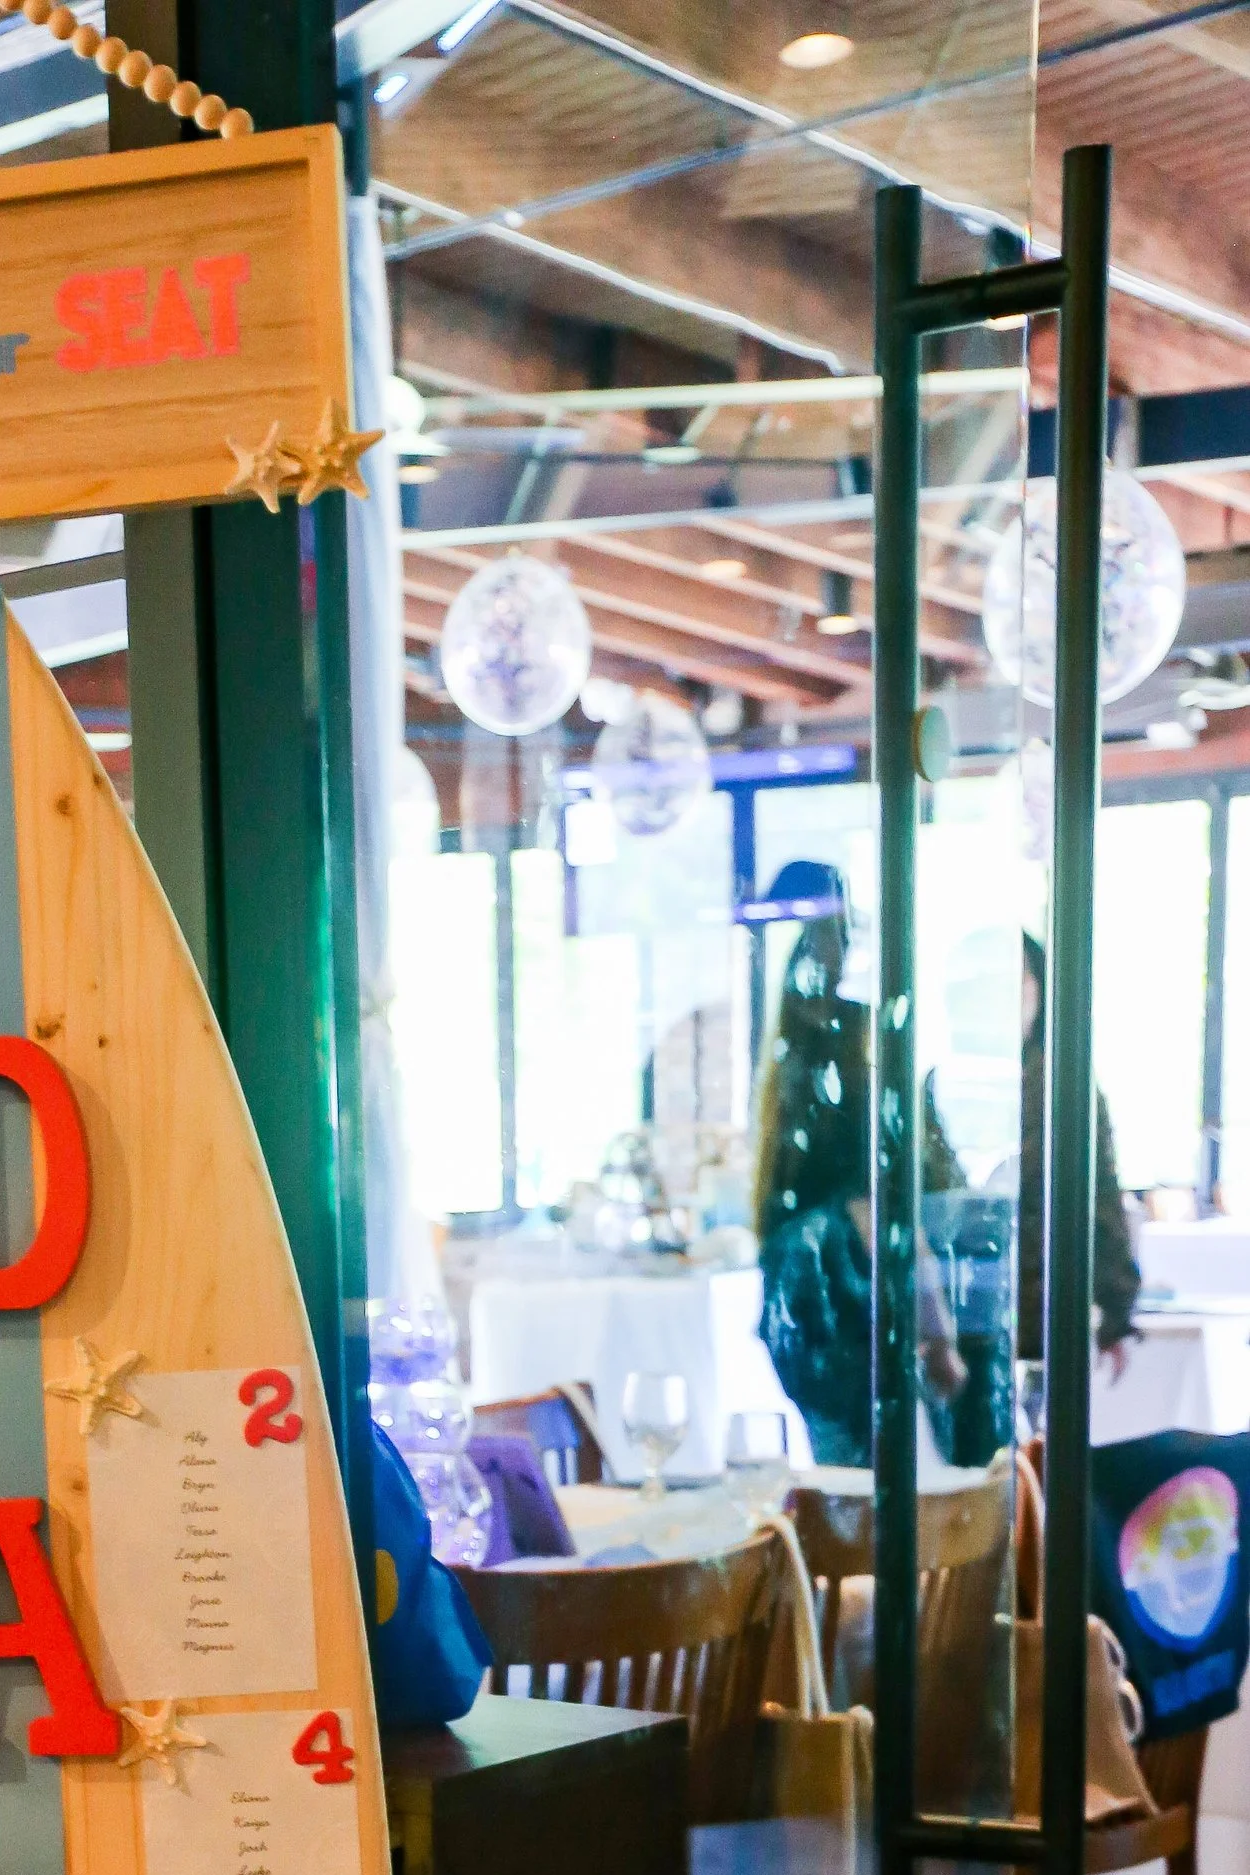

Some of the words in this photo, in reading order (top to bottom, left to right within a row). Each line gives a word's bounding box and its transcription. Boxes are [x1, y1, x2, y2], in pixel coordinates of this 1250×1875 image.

[55, 254, 251, 373] SEAT
[239, 1370, 303, 1448] 2
[292, 1710, 354, 1786] 4
